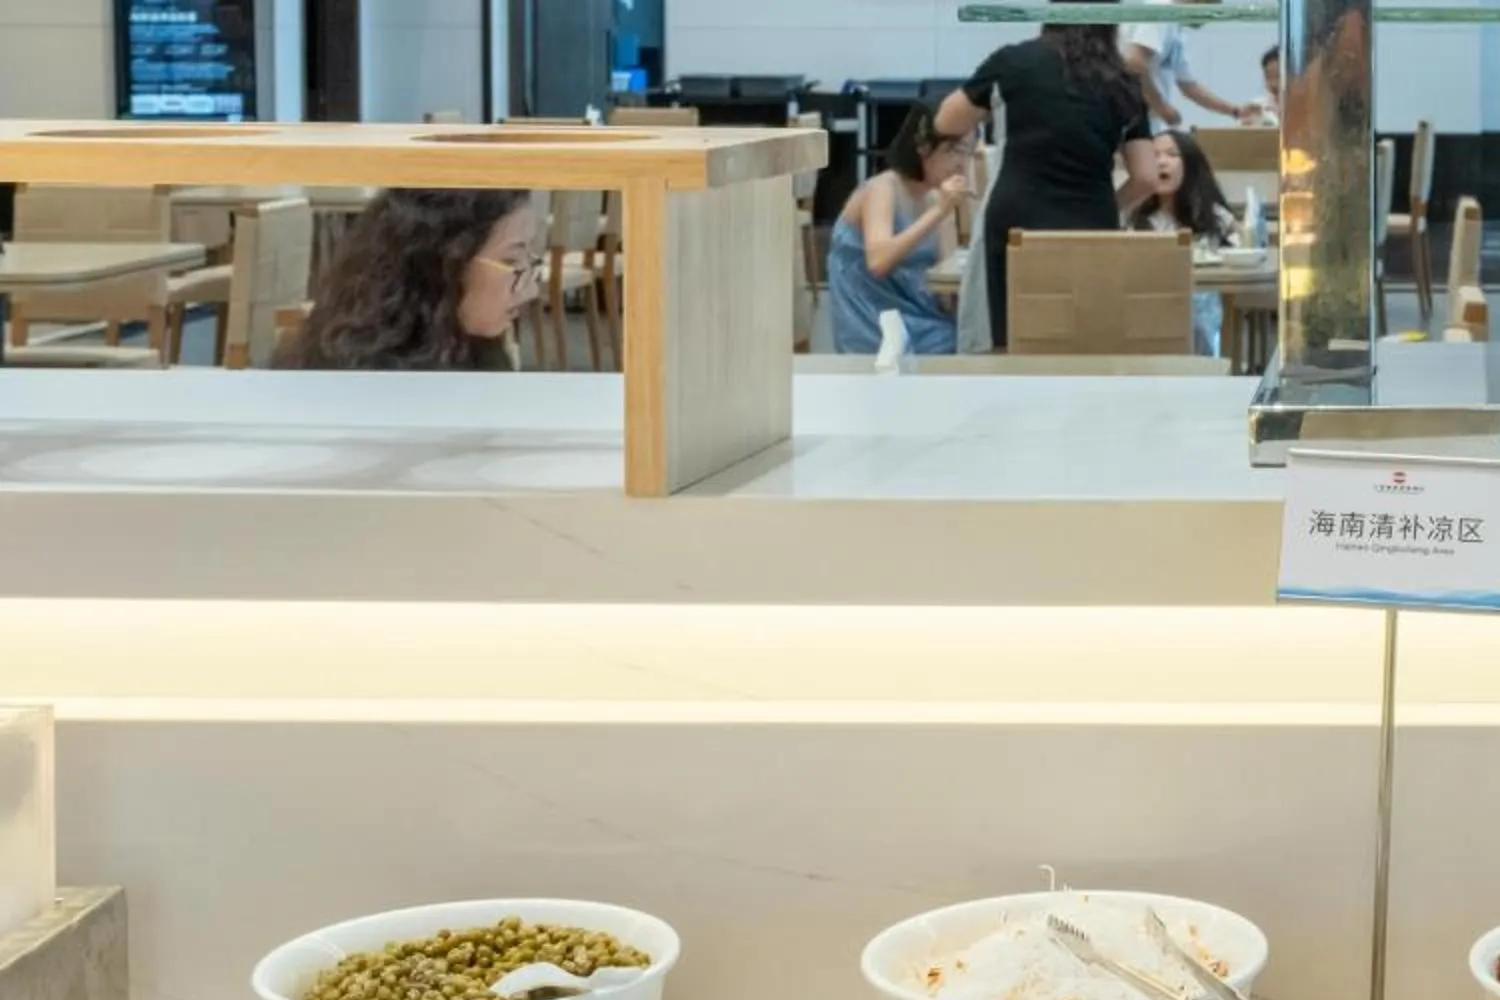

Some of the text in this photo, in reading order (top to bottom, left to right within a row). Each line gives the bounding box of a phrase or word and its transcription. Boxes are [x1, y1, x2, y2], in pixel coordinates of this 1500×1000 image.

[1308, 509, 1485, 543] 海南清补凉区
